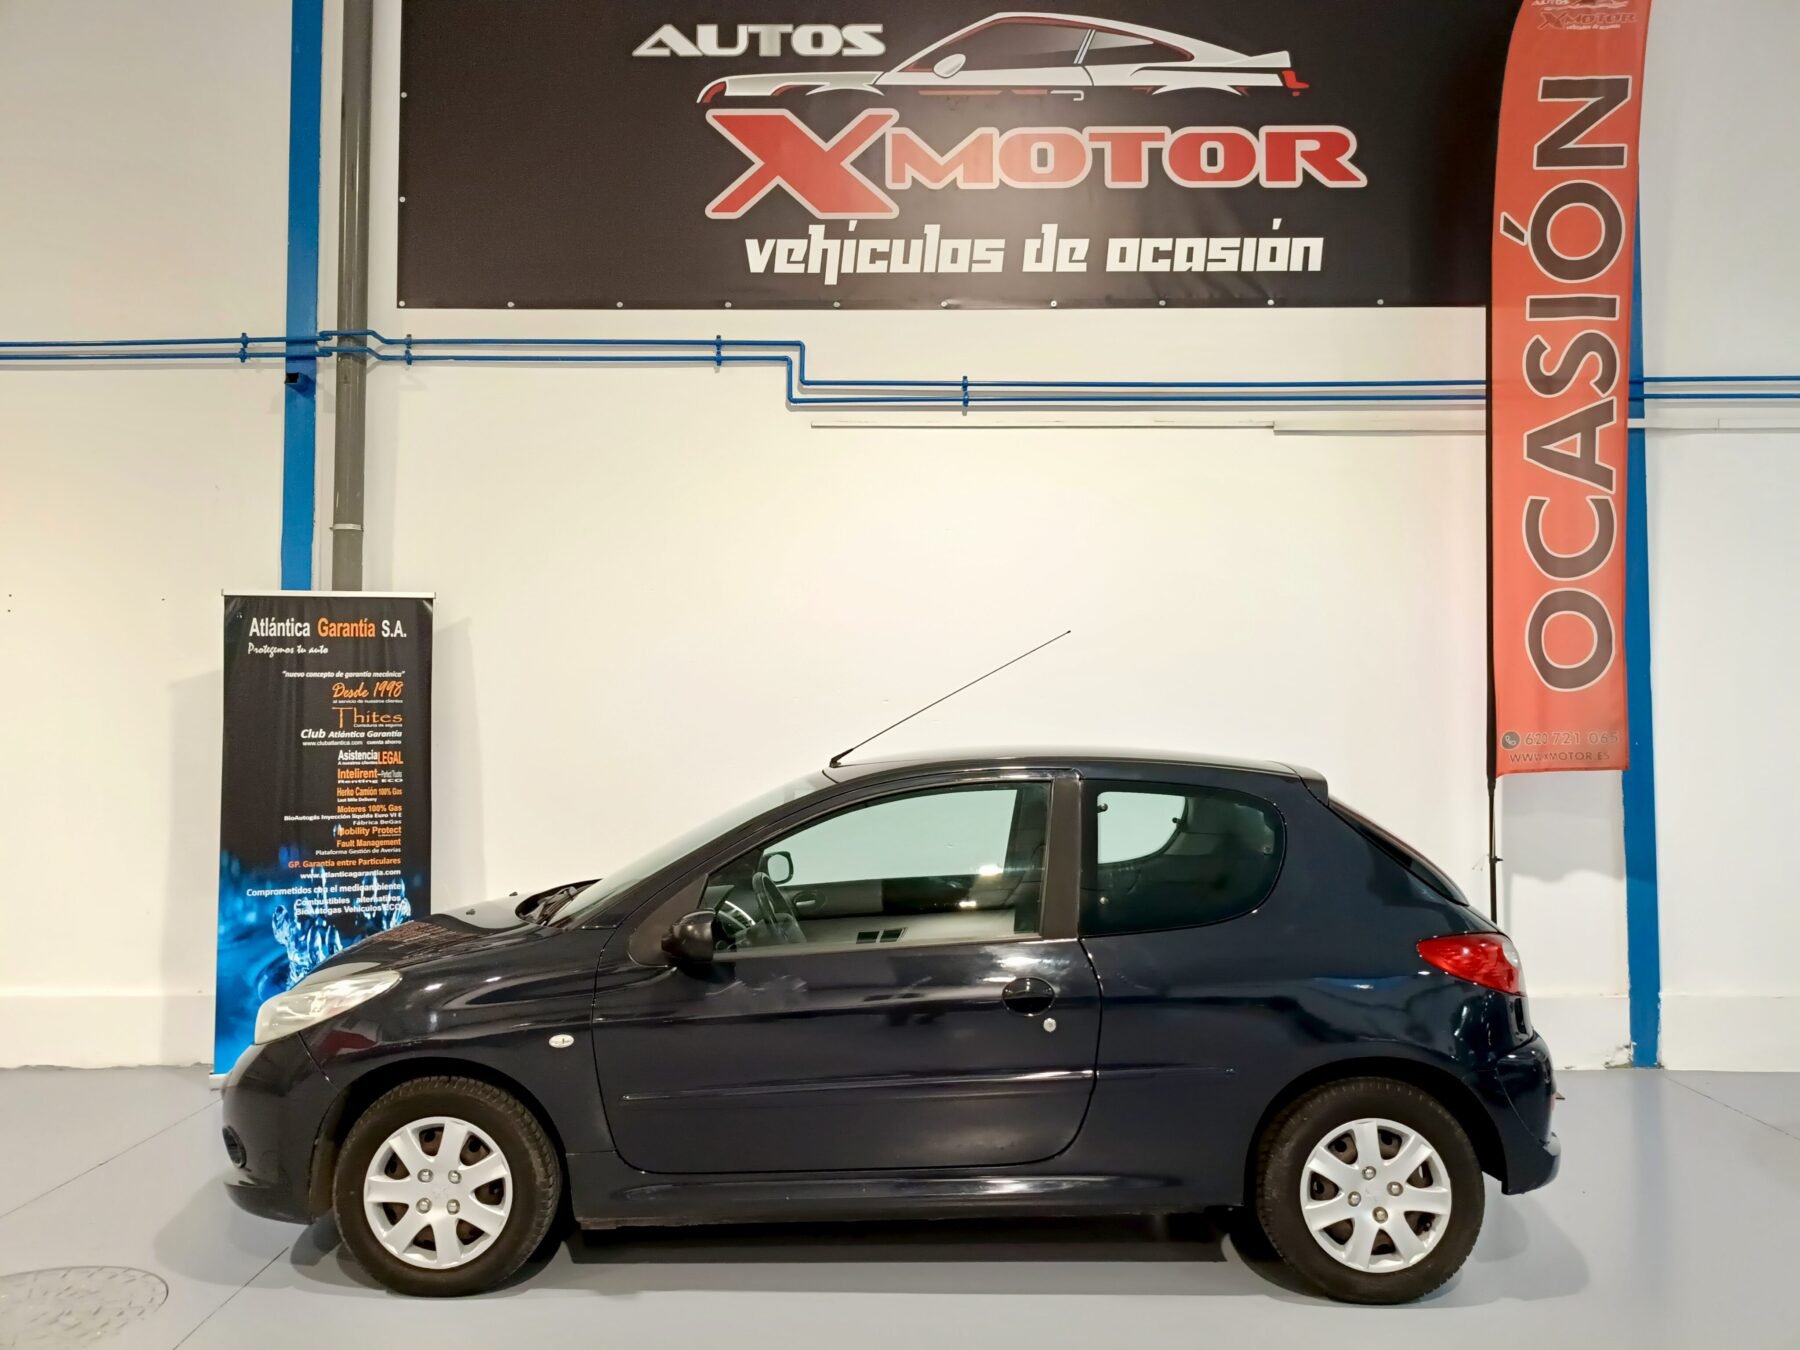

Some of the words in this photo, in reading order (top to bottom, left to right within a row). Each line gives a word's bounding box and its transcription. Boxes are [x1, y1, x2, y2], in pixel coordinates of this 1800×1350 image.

[632, 23, 886, 57] AUTOS
[1022, 223, 1090, 272] de
[1500, 75, 1632, 691] OCASIÓN
[249, 617, 310, 637] Atlántica
[318, 617, 376, 638] Garantía
[381, 619, 407, 638] S.A.
[247, 642, 294, 658] Protegemos
[297, 644, 307, 654] tu
[308, 644, 329, 654] auto
[306, 670, 335, 679] concepto
[335, 670, 344, 678] de
[332, 682, 369, 698] Desde
[373, 680, 404, 698] 1998
[300, 728, 326, 739] Club
[328, 730, 365, 738] Atlántica
[366, 729, 403, 738] Garantía
[1551, 730, 1580, 745] 721
[391, 786, 403, 795] Gas
[336, 805, 367, 814] Motores
[368, 804, 387, 813] 100%
[388, 803, 403, 812] Gas
[371, 825, 402, 835] Protect
[336, 839, 355, 848] Fault
[356, 838, 402, 848] Management
[348, 847, 371, 855] Gestión
[336, 858, 357, 866] entre
[358, 856, 402, 866] Particulares
[246, 886, 312, 898] Comprometidos
[329, 884, 338, 893] el
